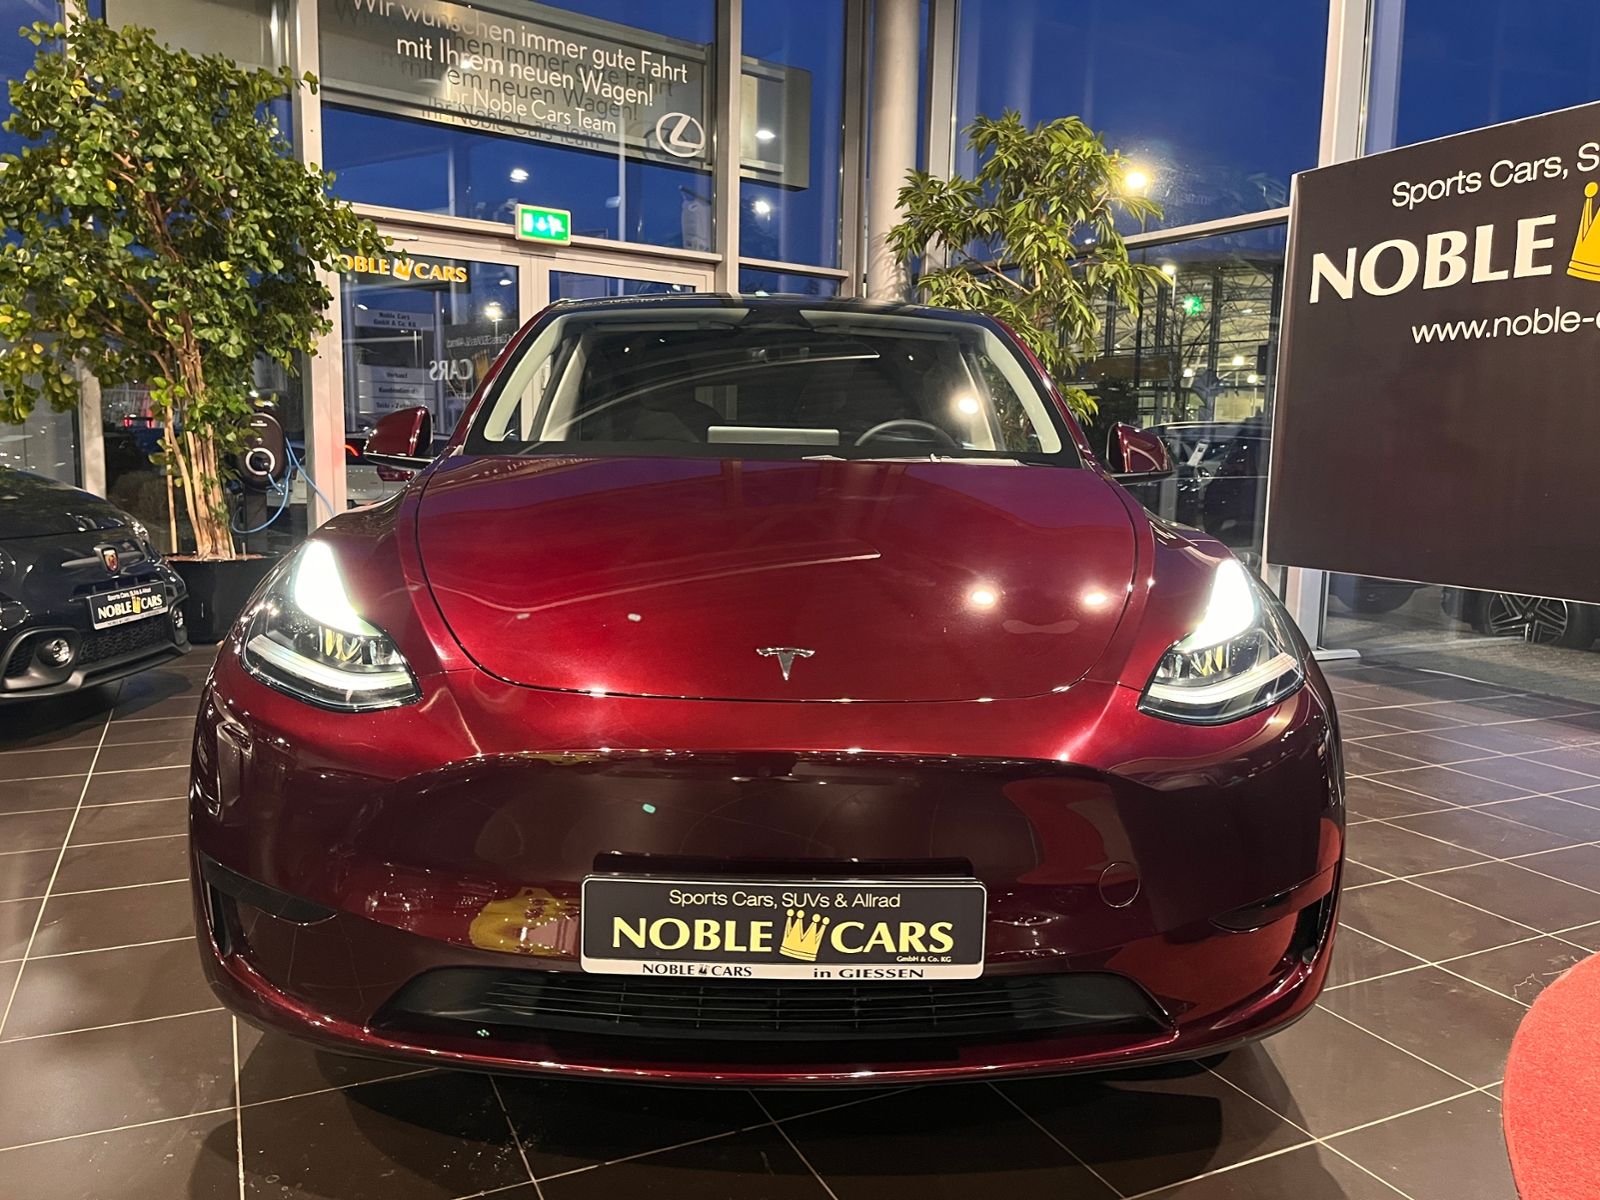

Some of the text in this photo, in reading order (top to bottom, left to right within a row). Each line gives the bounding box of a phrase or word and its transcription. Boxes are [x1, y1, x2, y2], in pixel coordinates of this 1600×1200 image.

[397, 37, 653, 106] mit Ihrem neuen Wagen!
[520, 26, 588, 60] immer
[592, 49, 636, 71] gute
[641, 50, 688, 84] Fahrt
[473, 86, 527, 117] Noble
[531, 99, 571, 125] Cars
[575, 107, 617, 134] Team
[1392, 171, 1482, 210] Sports
[1489, 156, 1569, 188] Cars,
[414, 263, 468, 283] CARS
[1309, 214, 1557, 304] NOBLE
[1412, 306, 1600, 344] www.noble-
[97, 601, 132, 619] NOBLE
[141, 594, 163, 609] CARS
[669, 889, 901, 909] Sports Cars, SUVs & Allrad
[612, 916, 954, 954] NOBLE CARS
[642, 963, 752, 977] NOBLE CARS
[813, 968, 925, 979] in GIESSEN
